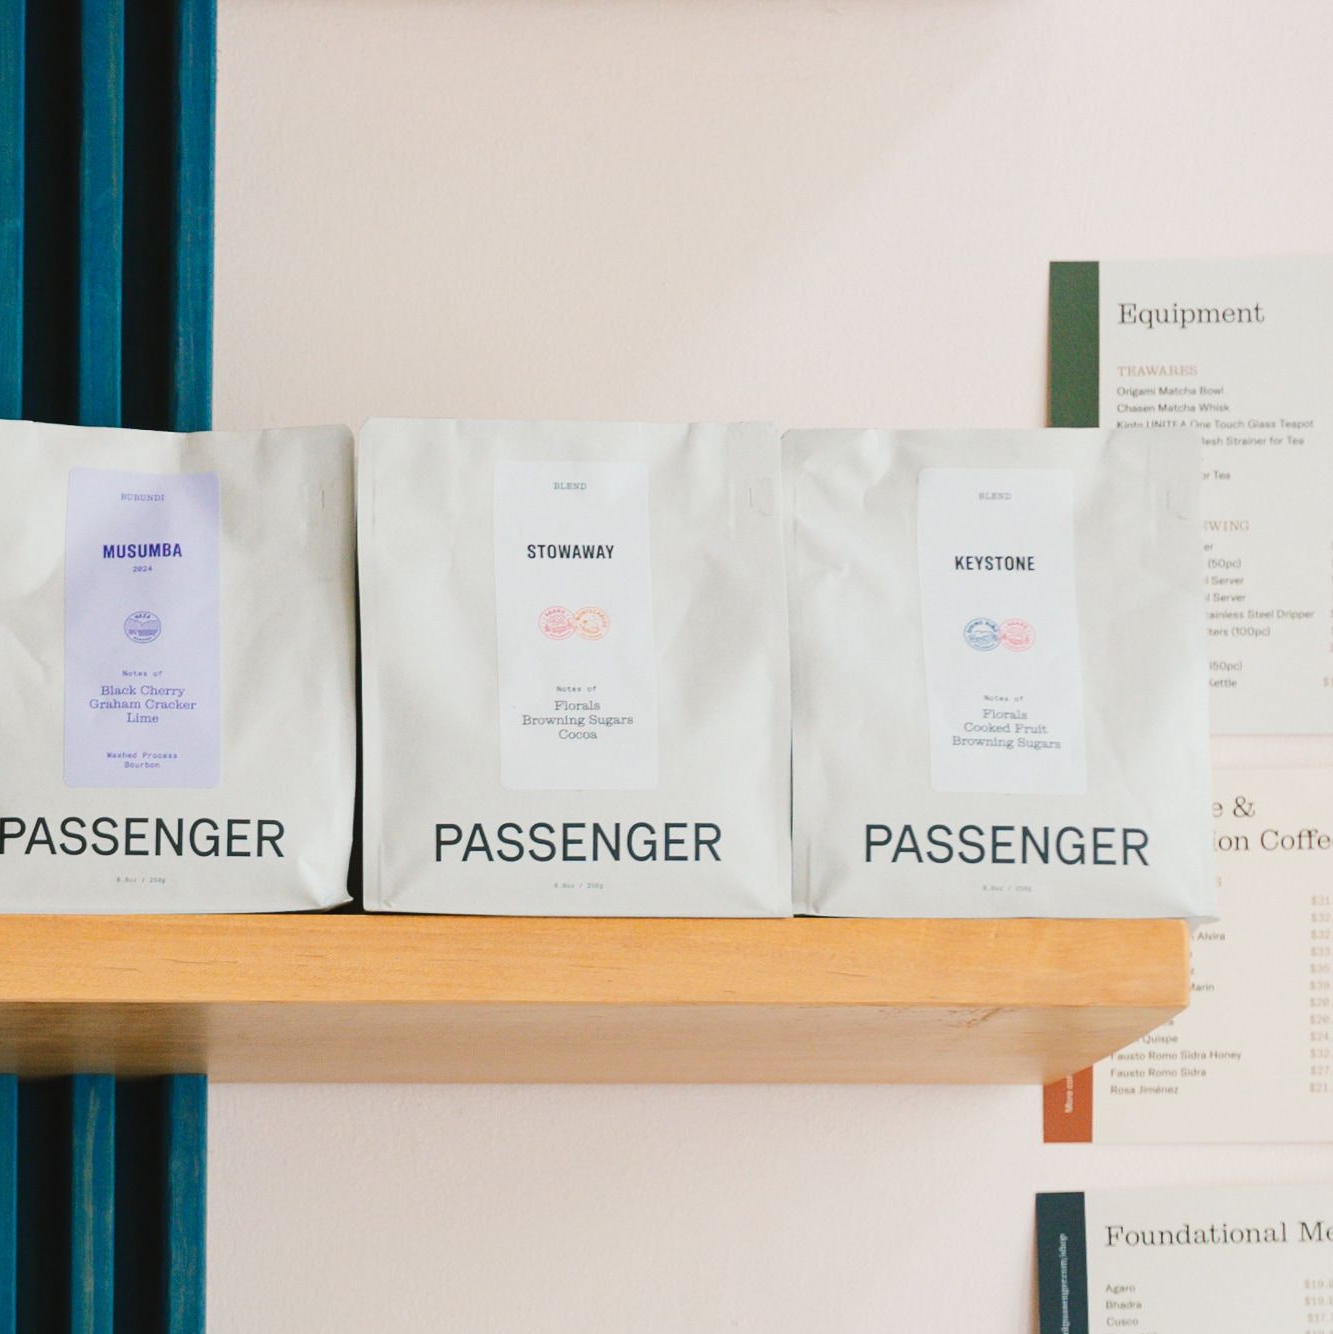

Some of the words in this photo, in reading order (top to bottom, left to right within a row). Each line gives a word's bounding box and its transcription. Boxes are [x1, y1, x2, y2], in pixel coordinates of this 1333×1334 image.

[1117, 303, 1265, 329] Equipment
[1116, 365, 1198, 377] TEAWARES
[1116, 387, 1156, 399] Origami
[1158, 386, 1197, 396] Matcha
[1116, 404, 1156, 413] Chasen
[1157, 403, 1196, 413] Matcha
[1198, 402, 1230, 412] Whisk
[102, 542, 183, 559] MUSUMBA
[526, 543, 615, 560] STOWAWAY
[132, 565, 153, 573] 2024
[954, 555, 1035, 572] KEYSTONE
[100, 684, 137, 696] Black
[140, 685, 185, 699] Cherry
[89, 697, 142, 710] Graham
[144, 698, 197, 710] Cracker
[554, 699, 601, 712] Florals
[126, 711, 160, 724] Lime
[522, 713, 586, 728] Browning
[588, 713, 634, 728] Sugars
[982, 708, 1028, 720] Florals
[558, 728, 598, 740] Cocoa
[963, 721, 1011, 734] Cooked
[1014, 722, 1048, 735] Fruit
[952, 734, 1014, 751] Browning
[1017, 737, 1061, 751] Sugars
[1232, 796, 1256, 818] &
[435, 821, 722, 863] PASSENGER
[865, 823, 1149, 867] PASSENGER
[1109, 1068, 1146, 1078] Fausto
[1147, 1067, 1178, 1077] Romo
[1180, 1067, 1207, 1077] Sidra
[1110, 1084, 1136, 1095] Rosa
[1105, 1221, 1287, 1247] Foundational
[1105, 1283, 1136, 1295] Agaro
[1105, 1300, 1143, 1310] Bhadra
[1105, 1316, 1139, 1327] Cusco
